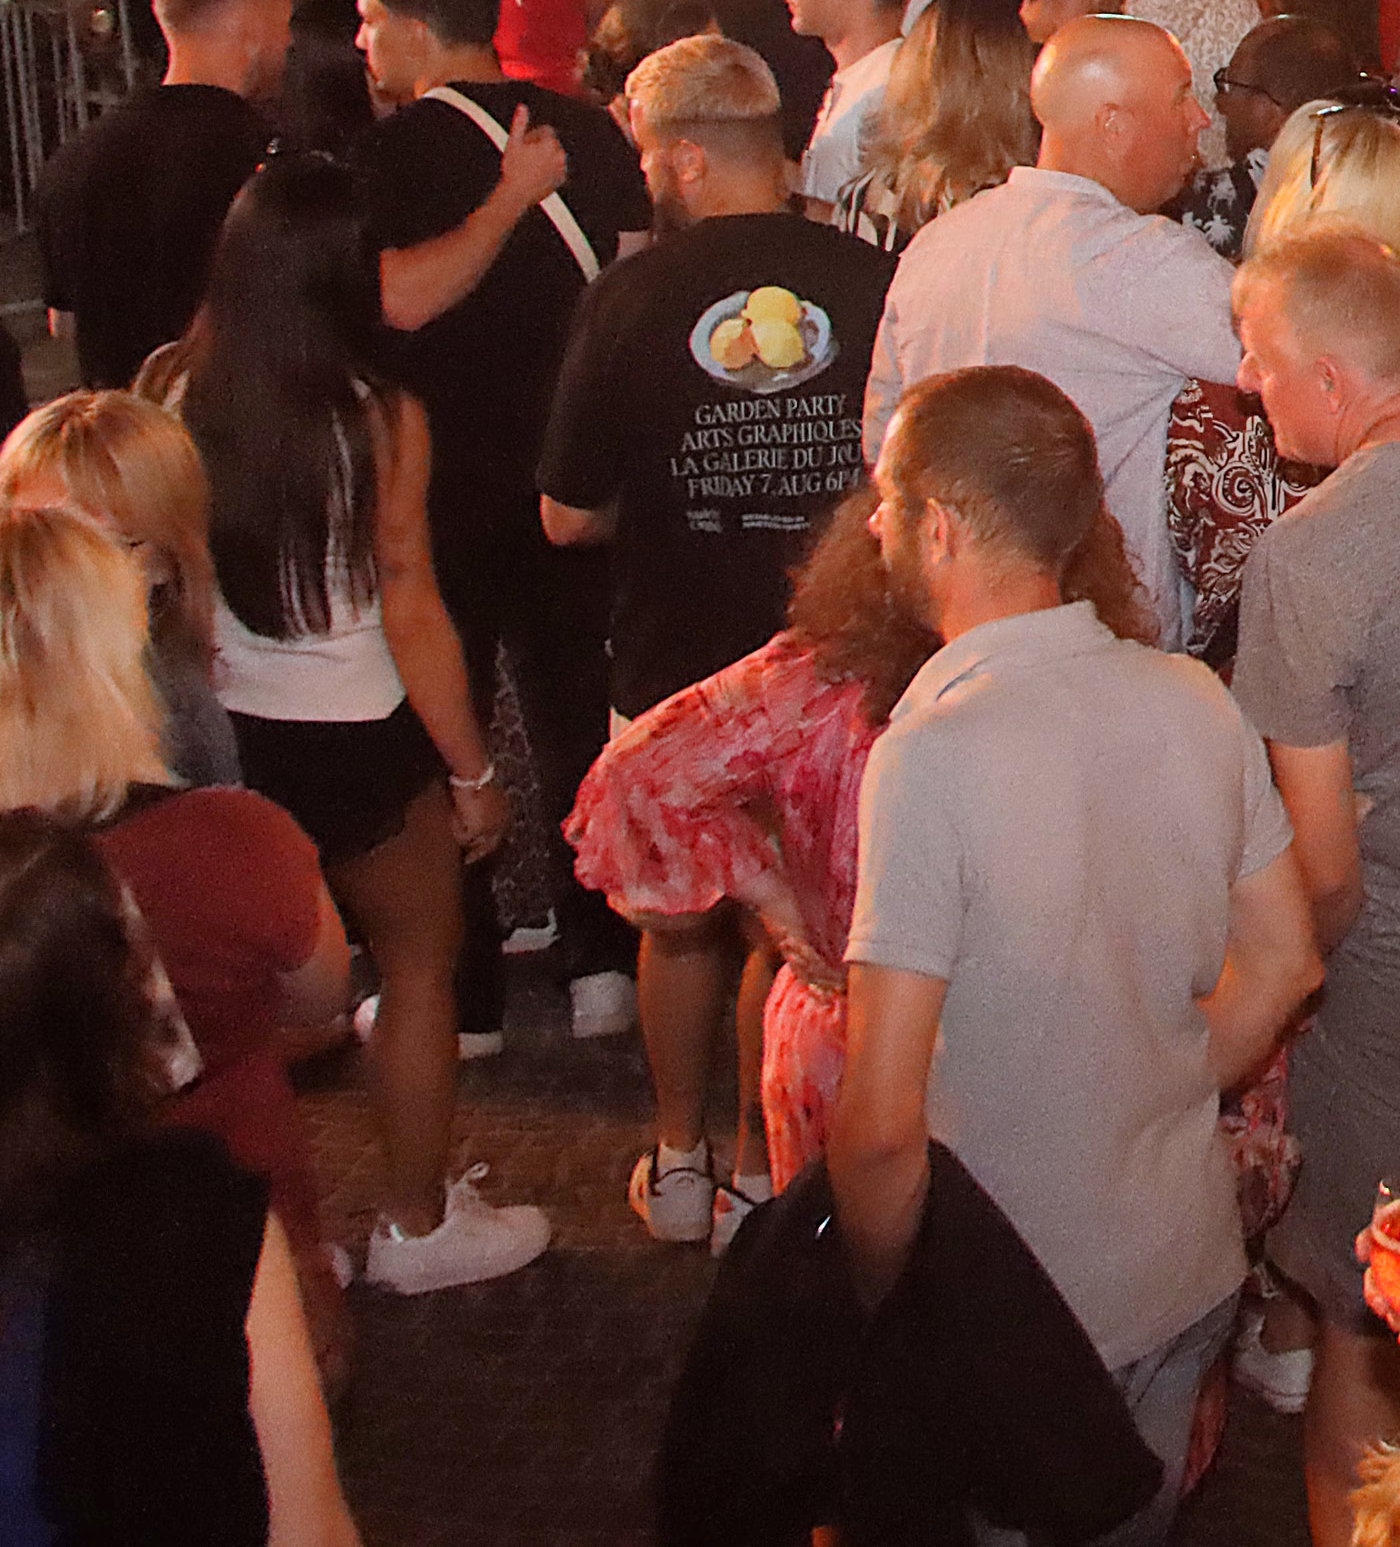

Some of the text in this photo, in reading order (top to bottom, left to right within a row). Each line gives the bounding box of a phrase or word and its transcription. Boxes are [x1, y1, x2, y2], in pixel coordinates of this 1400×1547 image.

[694, 394, 847, 426] GARDEN PARTY
[680, 419, 863, 452] ARTS GRAPHIQUES
[670, 443, 863, 477] LA GALERIE DU JOU
[687, 473, 756, 499] FRIDAY
[778, 471, 822, 497] AUG
